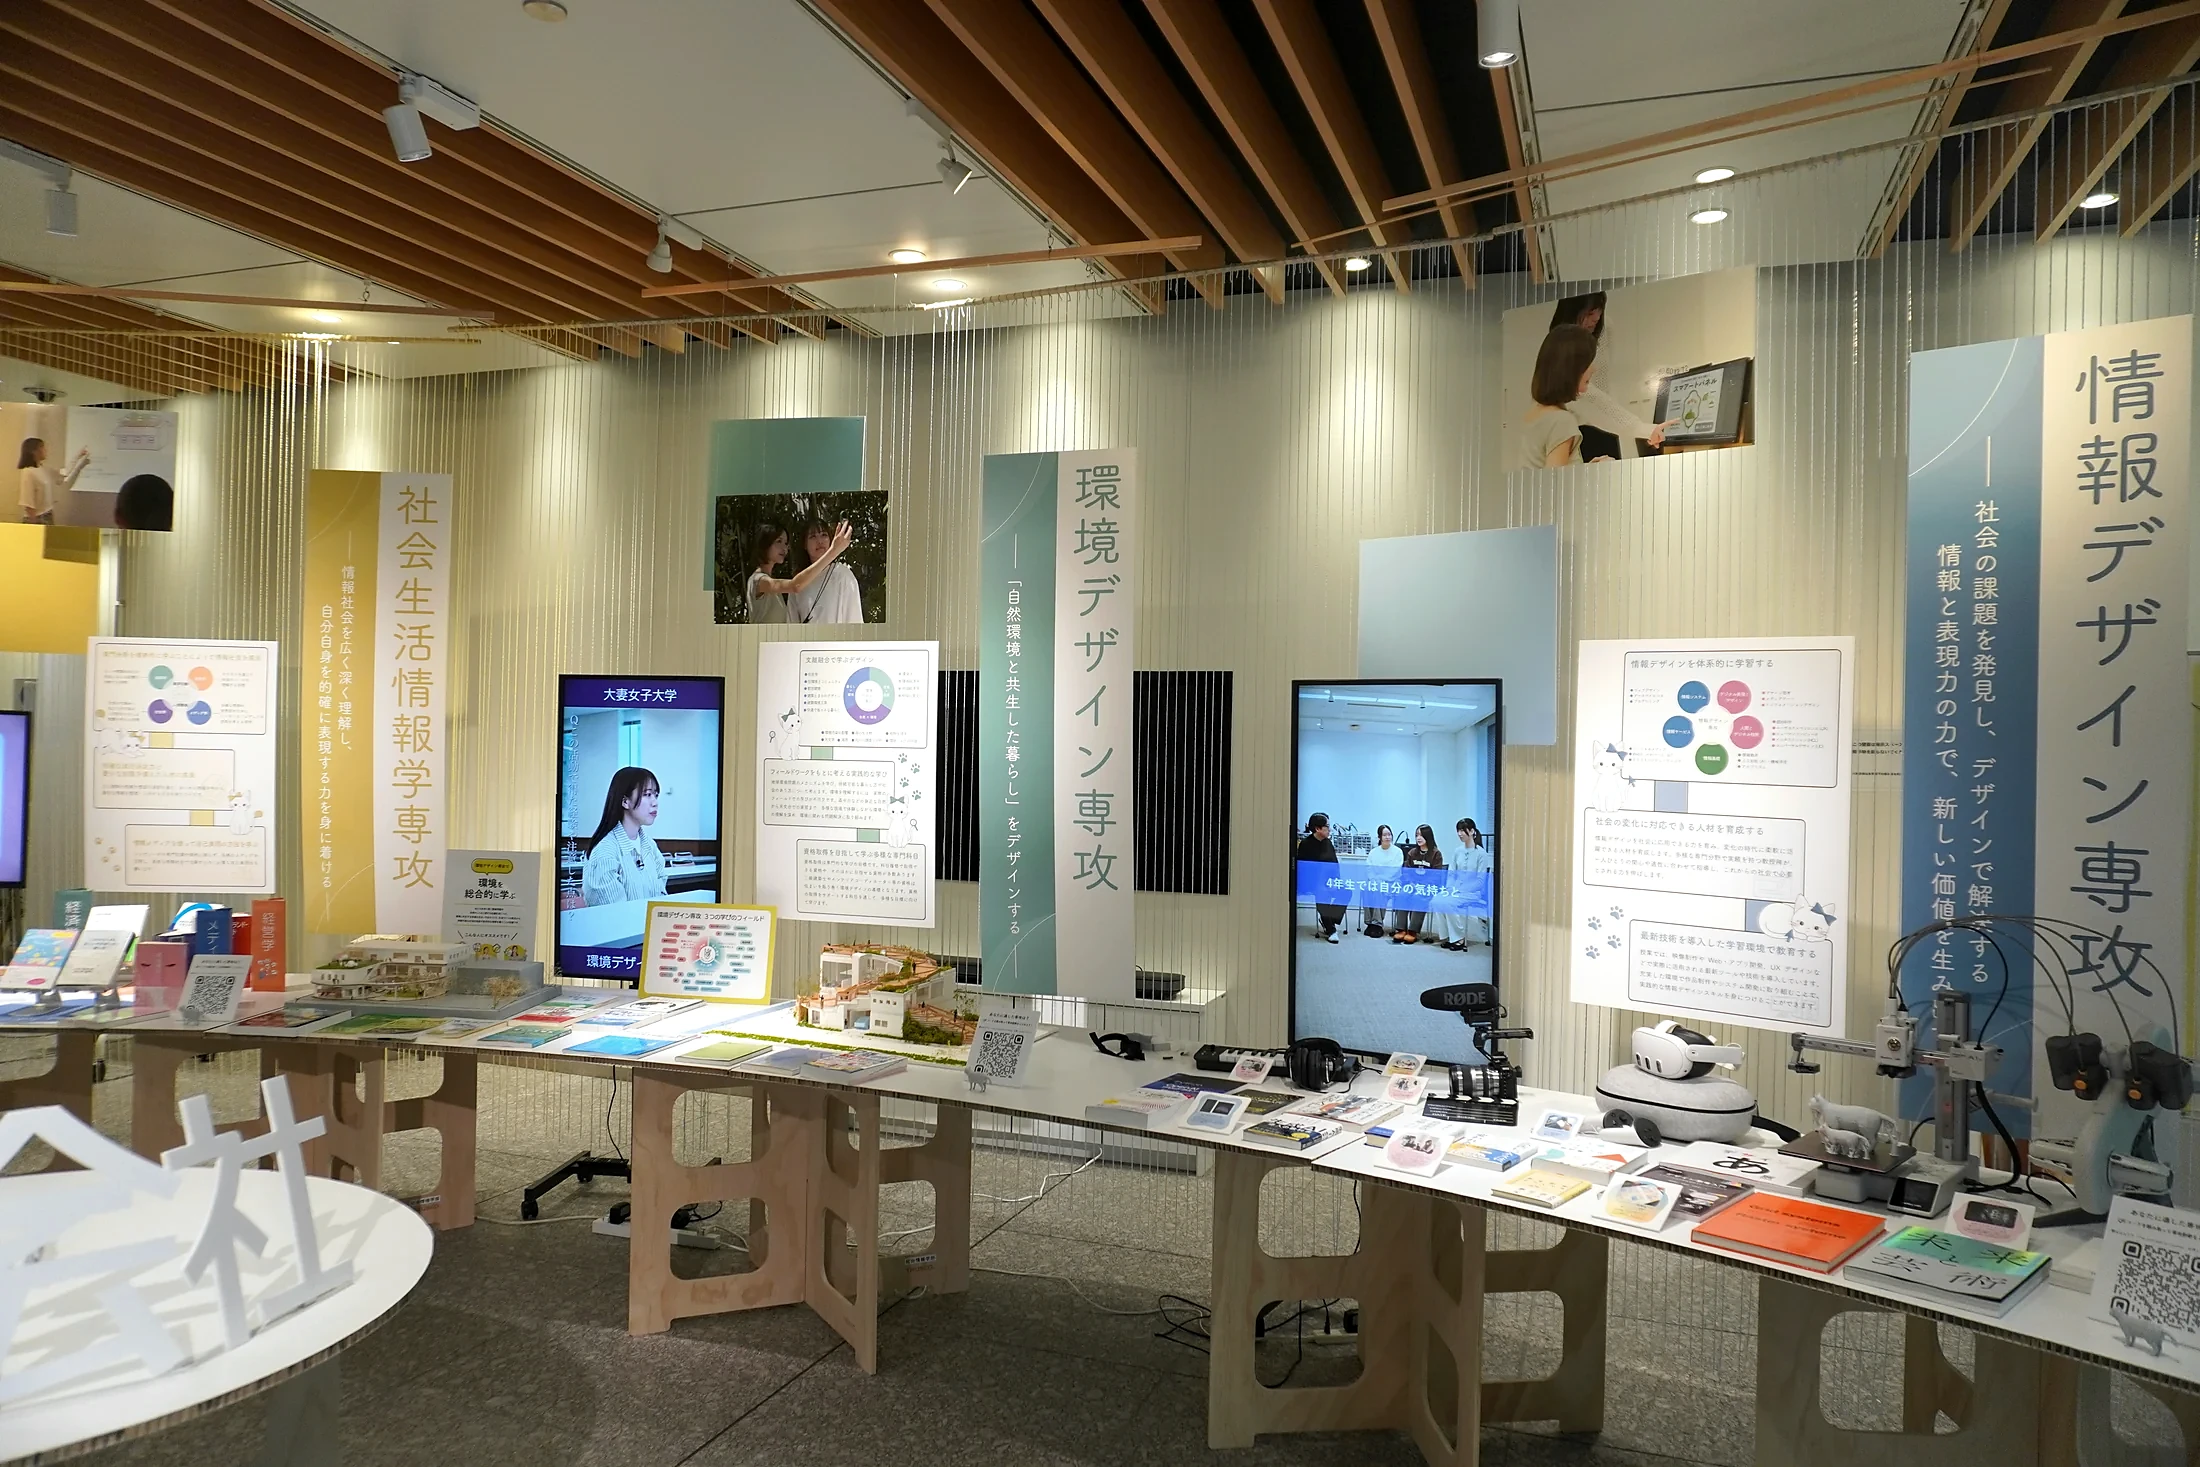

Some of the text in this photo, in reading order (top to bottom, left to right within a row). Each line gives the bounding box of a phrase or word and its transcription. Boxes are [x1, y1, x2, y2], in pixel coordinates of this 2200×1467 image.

[337, 565, 356, 751] 情報社会を広く深く理解し、
[1630, 658, 1774, 669] 情報デザインを体系的に学習する
[1073, 464, 1121, 891] 環境デザイン専攻
[2068, 349, 2165, 997] 情報デザイン専攻
[391, 485, 438, 889] 社会生活情報学専攻
[603, 688, 677, 703] 大妻女子大学
[318, 604, 334, 888] 自分自身を的確に表現する力を身に着ける
[1004, 580, 1023, 935] 「自然環境と共生した暮らし」をデザインする
[1595, 816, 1764, 836] 社会の変化に対応できる人材を育成する
[464, 889, 517, 900] 総合的に学ぶ
[1326, 876, 1461, 899] 4年生では自分の気持ちと
[1640, 931, 1816, 959] 最新技術を導入した学習環境で教育する
[586, 954, 643, 970] 環境デザ
[1443, 991, 1487, 1006] RØDE
